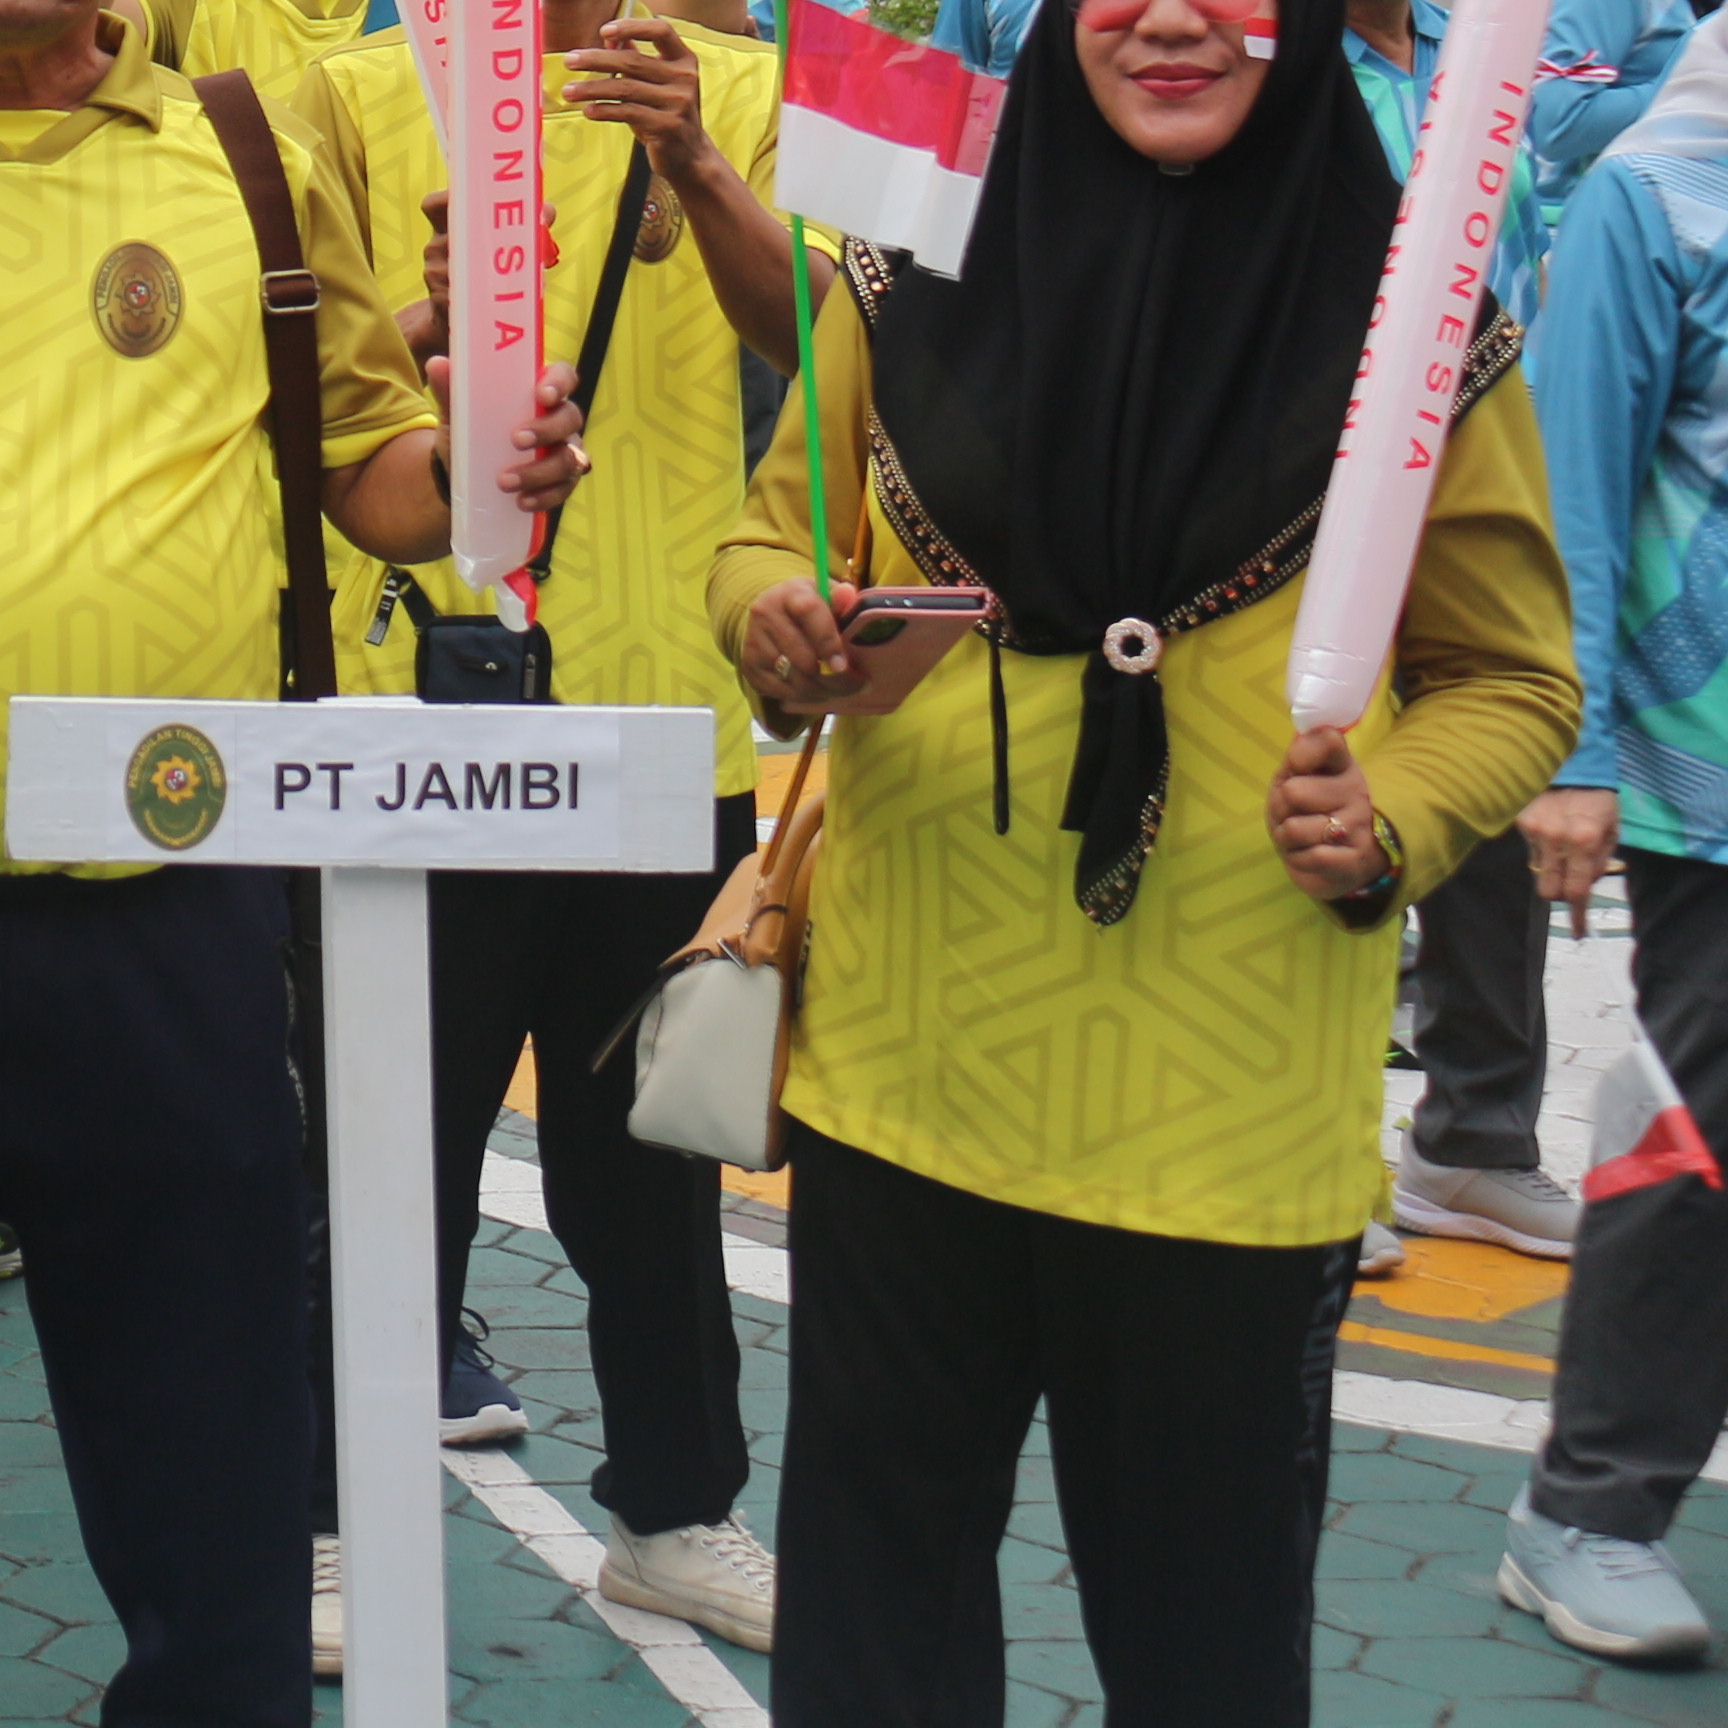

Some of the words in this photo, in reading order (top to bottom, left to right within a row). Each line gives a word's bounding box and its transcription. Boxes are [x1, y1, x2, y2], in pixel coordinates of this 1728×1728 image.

[1401, 78, 1528, 473] INDONESIA
[272, 761, 354, 812] PT
[375, 760, 579, 812] JAMBI
